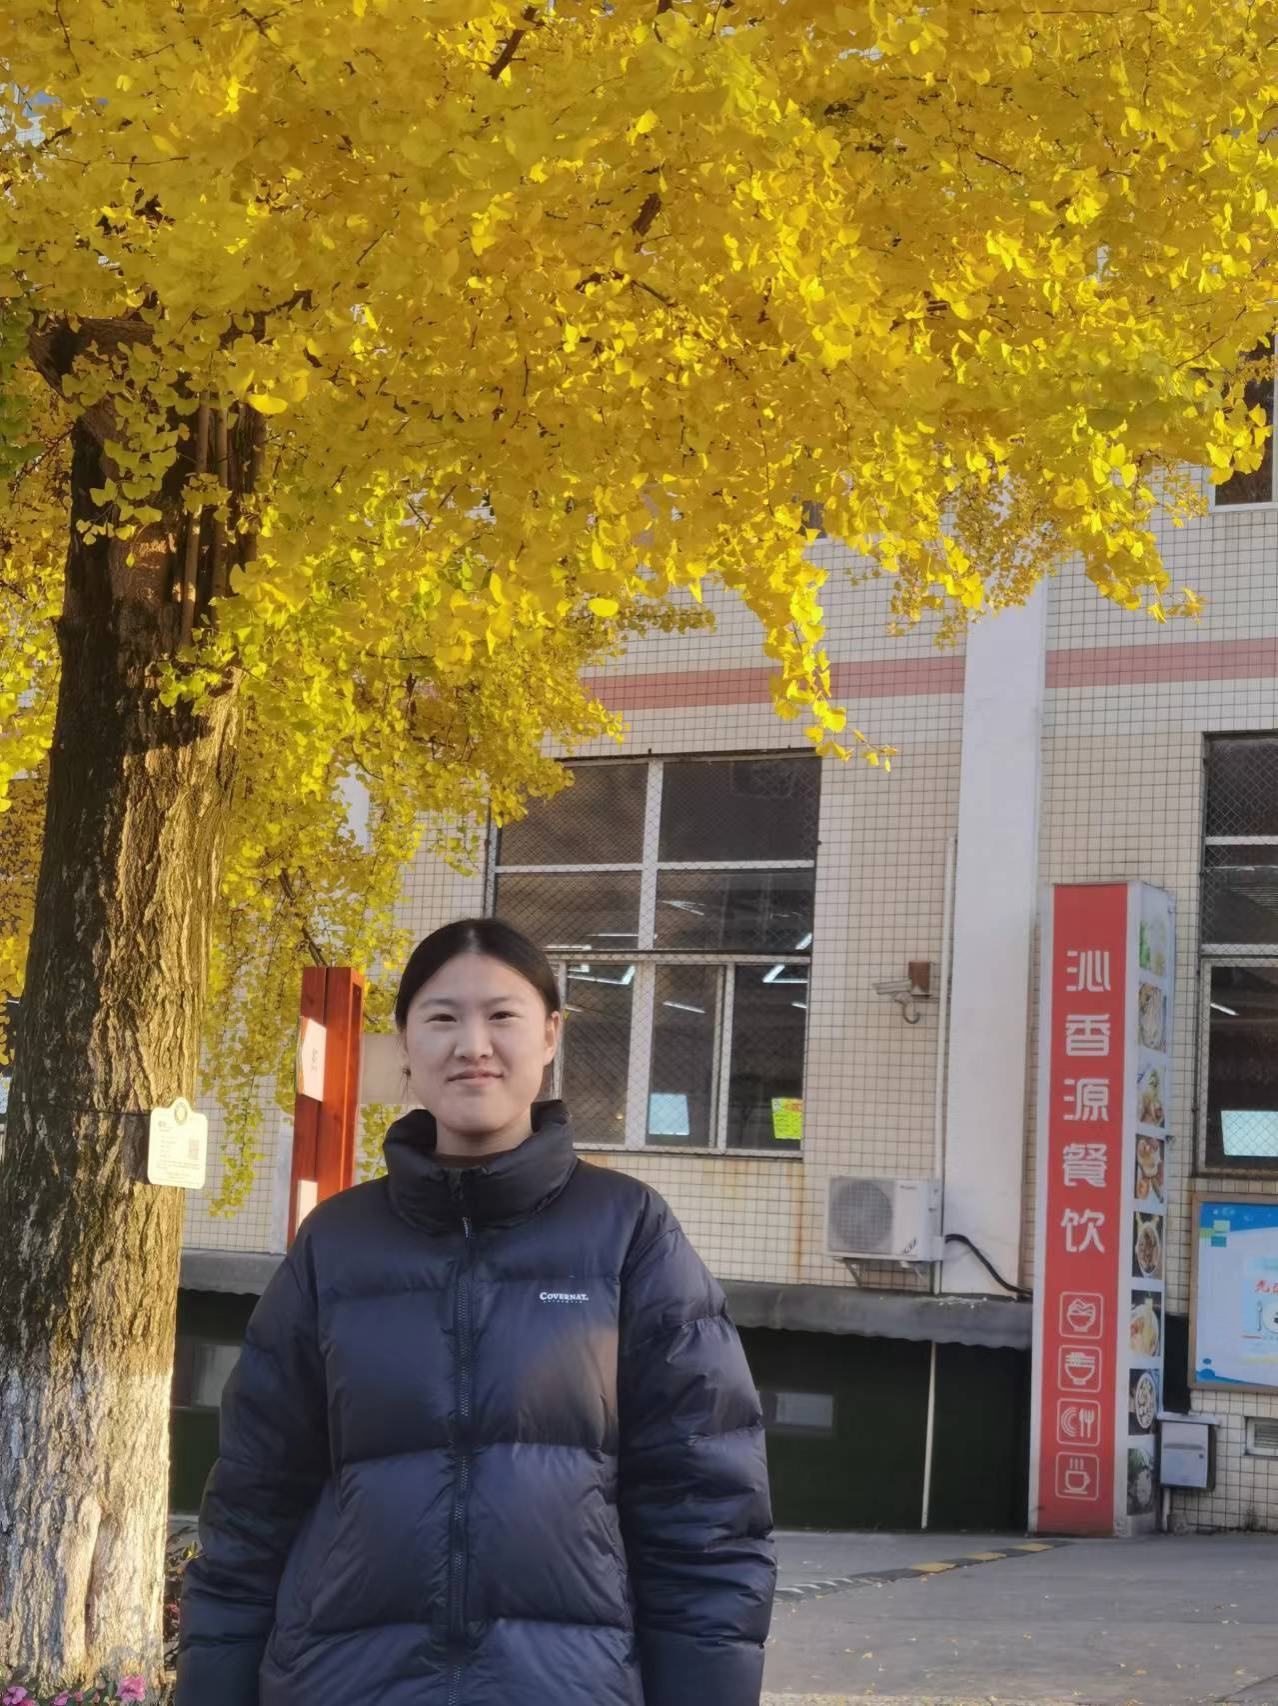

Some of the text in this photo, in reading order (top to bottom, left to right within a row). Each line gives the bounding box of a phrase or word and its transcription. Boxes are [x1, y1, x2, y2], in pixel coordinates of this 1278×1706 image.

[1060, 949, 1112, 1254] 沁香源餐饮
